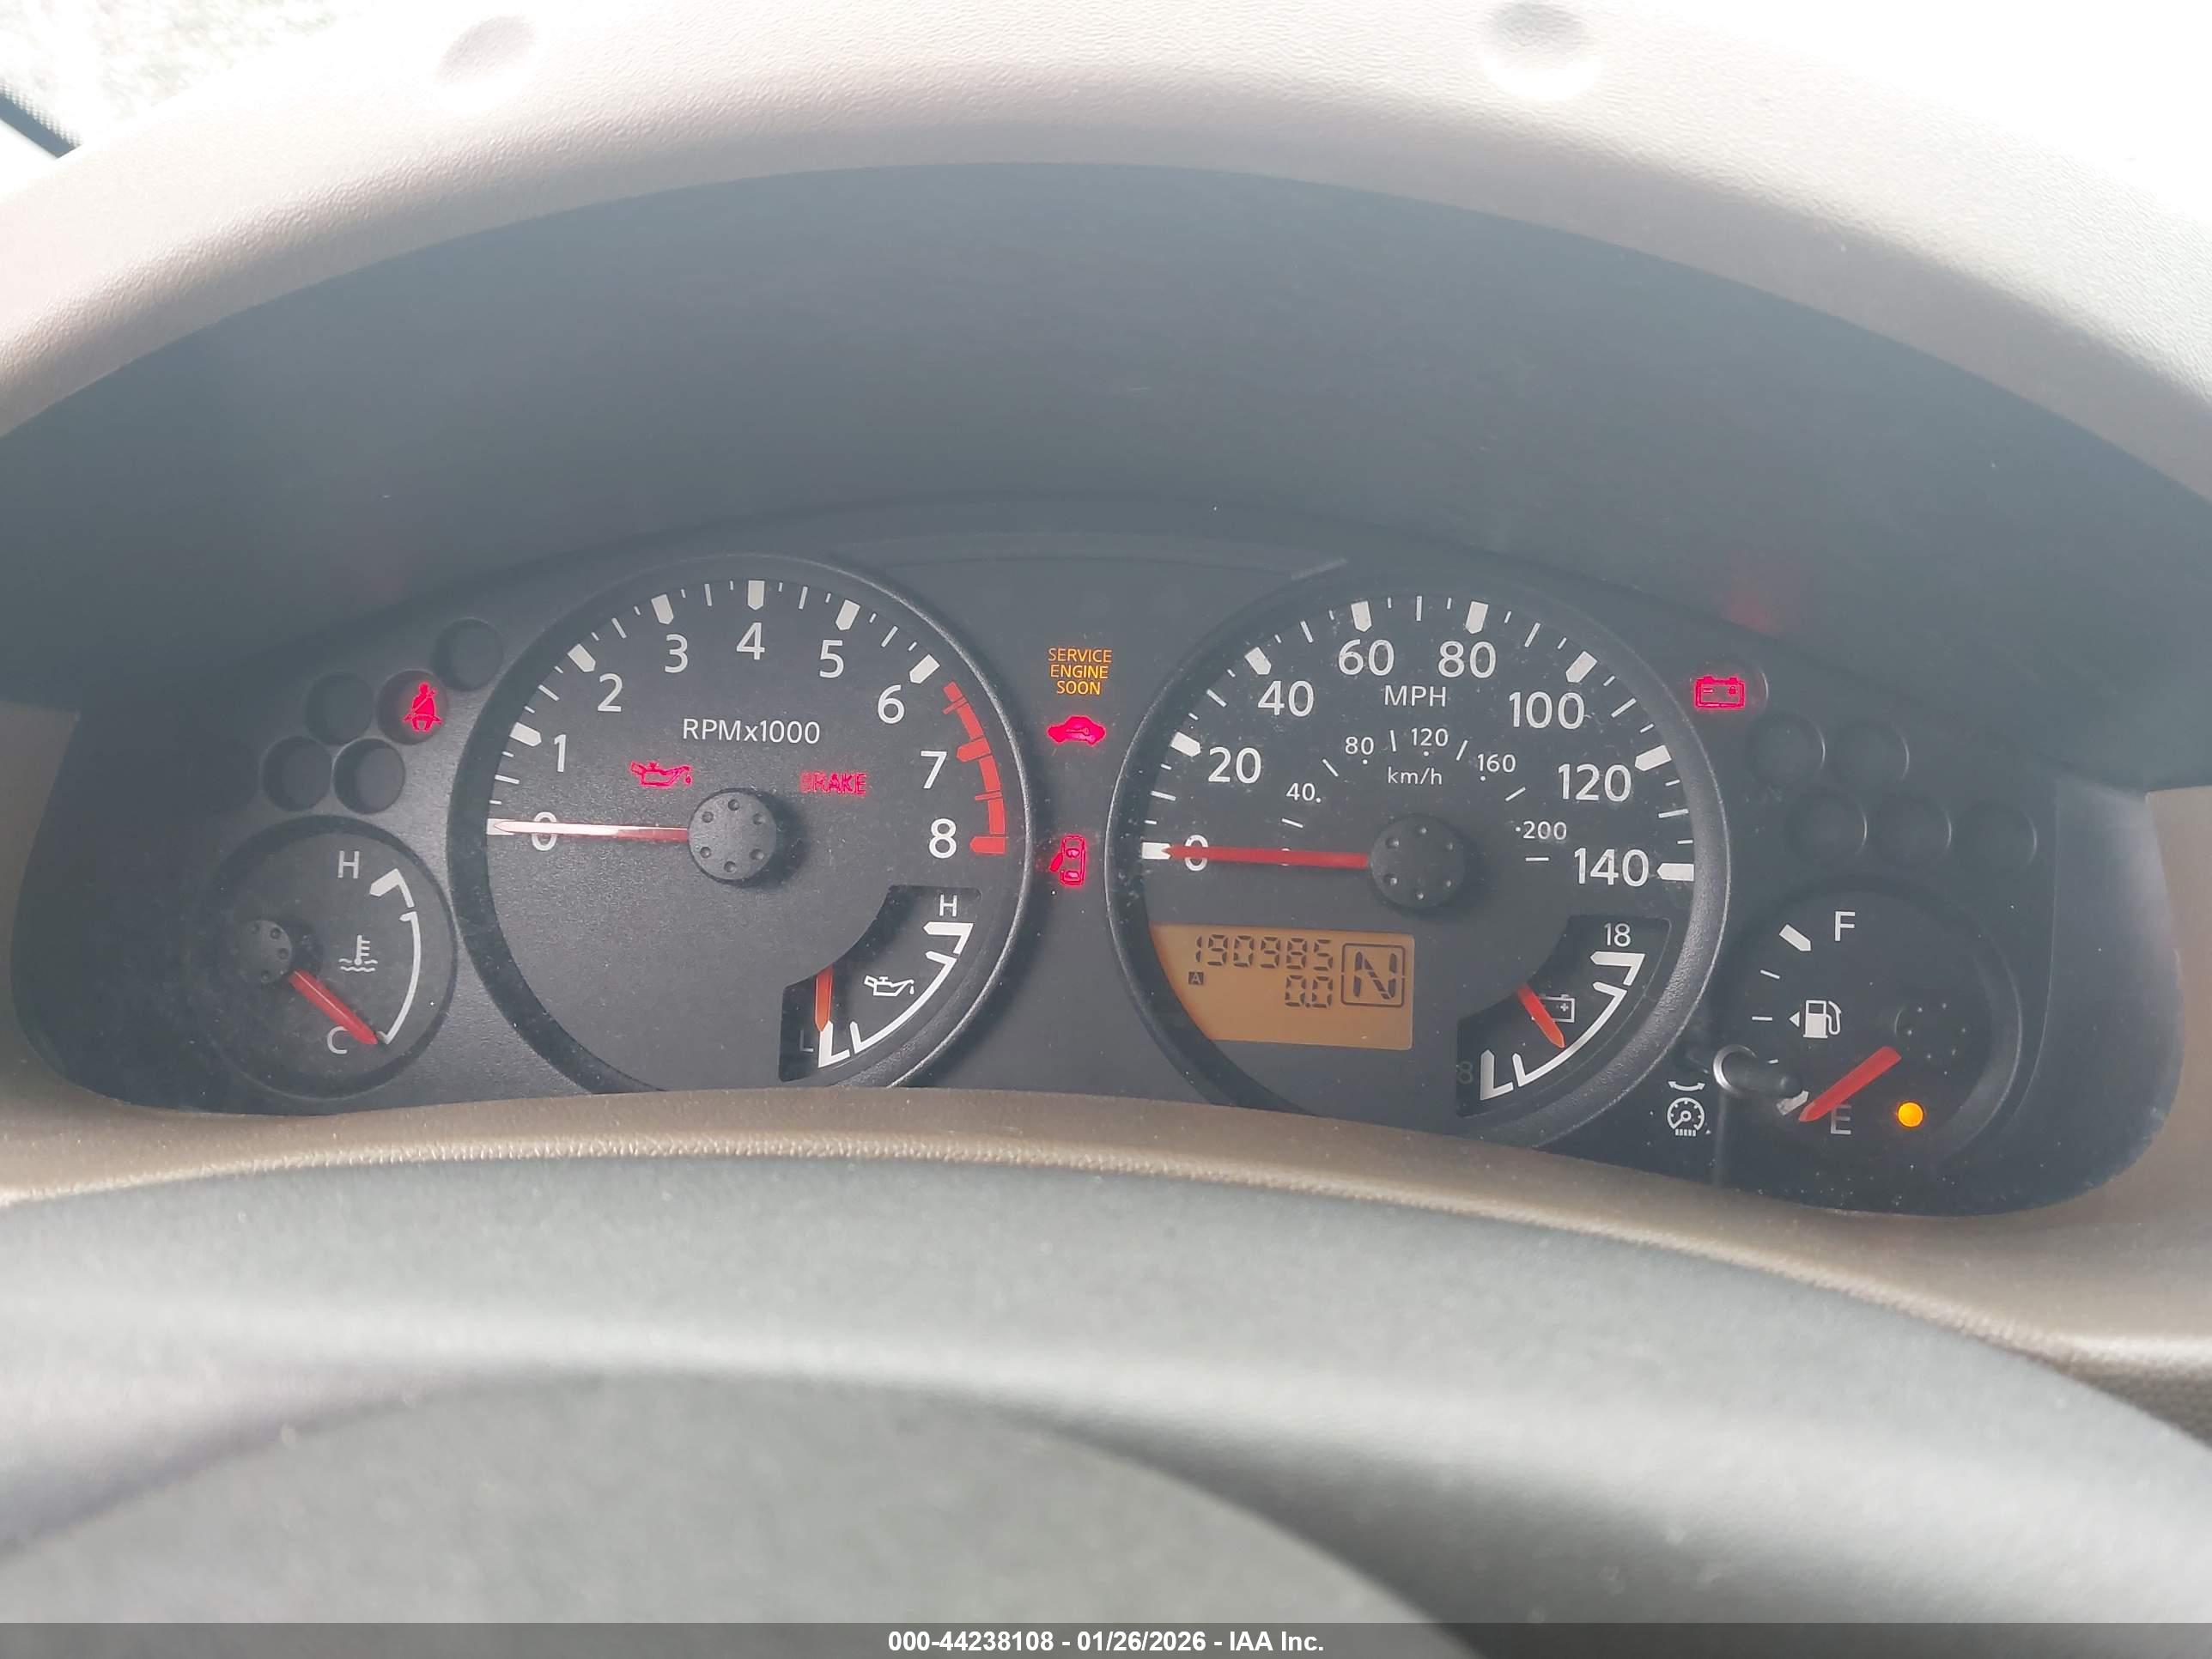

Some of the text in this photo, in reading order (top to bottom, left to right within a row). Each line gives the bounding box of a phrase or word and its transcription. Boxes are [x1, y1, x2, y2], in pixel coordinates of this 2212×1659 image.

[665, 635, 688, 673] 3
[737, 623, 764, 659] 4
[819, 640, 844, 678] 5
[1048, 647, 1112, 663] SERVICE
[1339, 640, 1395, 677] 60
[1050, 664, 1109, 679] ENGINE
[1438, 641, 1496, 678] 80
[598, 674, 623, 712] 2
[878, 685, 904, 724] 6
[1056, 680, 1101, 696] SOON
[1258, 680, 1314, 717] 40
[1384, 685, 1447, 708] MPH
[1509, 691, 1584, 729] 100
[683, 719, 821, 744] RPMx1000
[1345, 737, 1374, 755] 80
[1412, 728, 1449, 747] 120
[554, 734, 565, 771] 1
[921, 751, 946, 789] 7
[1208, 748, 1261, 785] 20
[1477, 753, 1516, 773] 160
[1388, 767, 1443, 786] km/h
[1559, 764, 1632, 802] 120
[532, 811, 557, 851] 0
[929, 818, 957, 858] 8
[1522, 821, 1567, 841] 200
[337, 850, 360, 878] H
[1184, 835, 1208, 872] 0
[1574, 849, 1650, 886] 140
[939, 896, 957, 916] H
[1604, 923, 1631, 946] 18
[1835, 911, 1855, 941] F
[1195, 934, 1333, 971] 190985
[1189, 972, 1203, 985] A
[1285, 975, 1333, 1008] 0.0
[1352, 951, 1398, 1000] N
[327, 1026, 348, 1054] C
[1831, 1104, 1851, 1135] E
